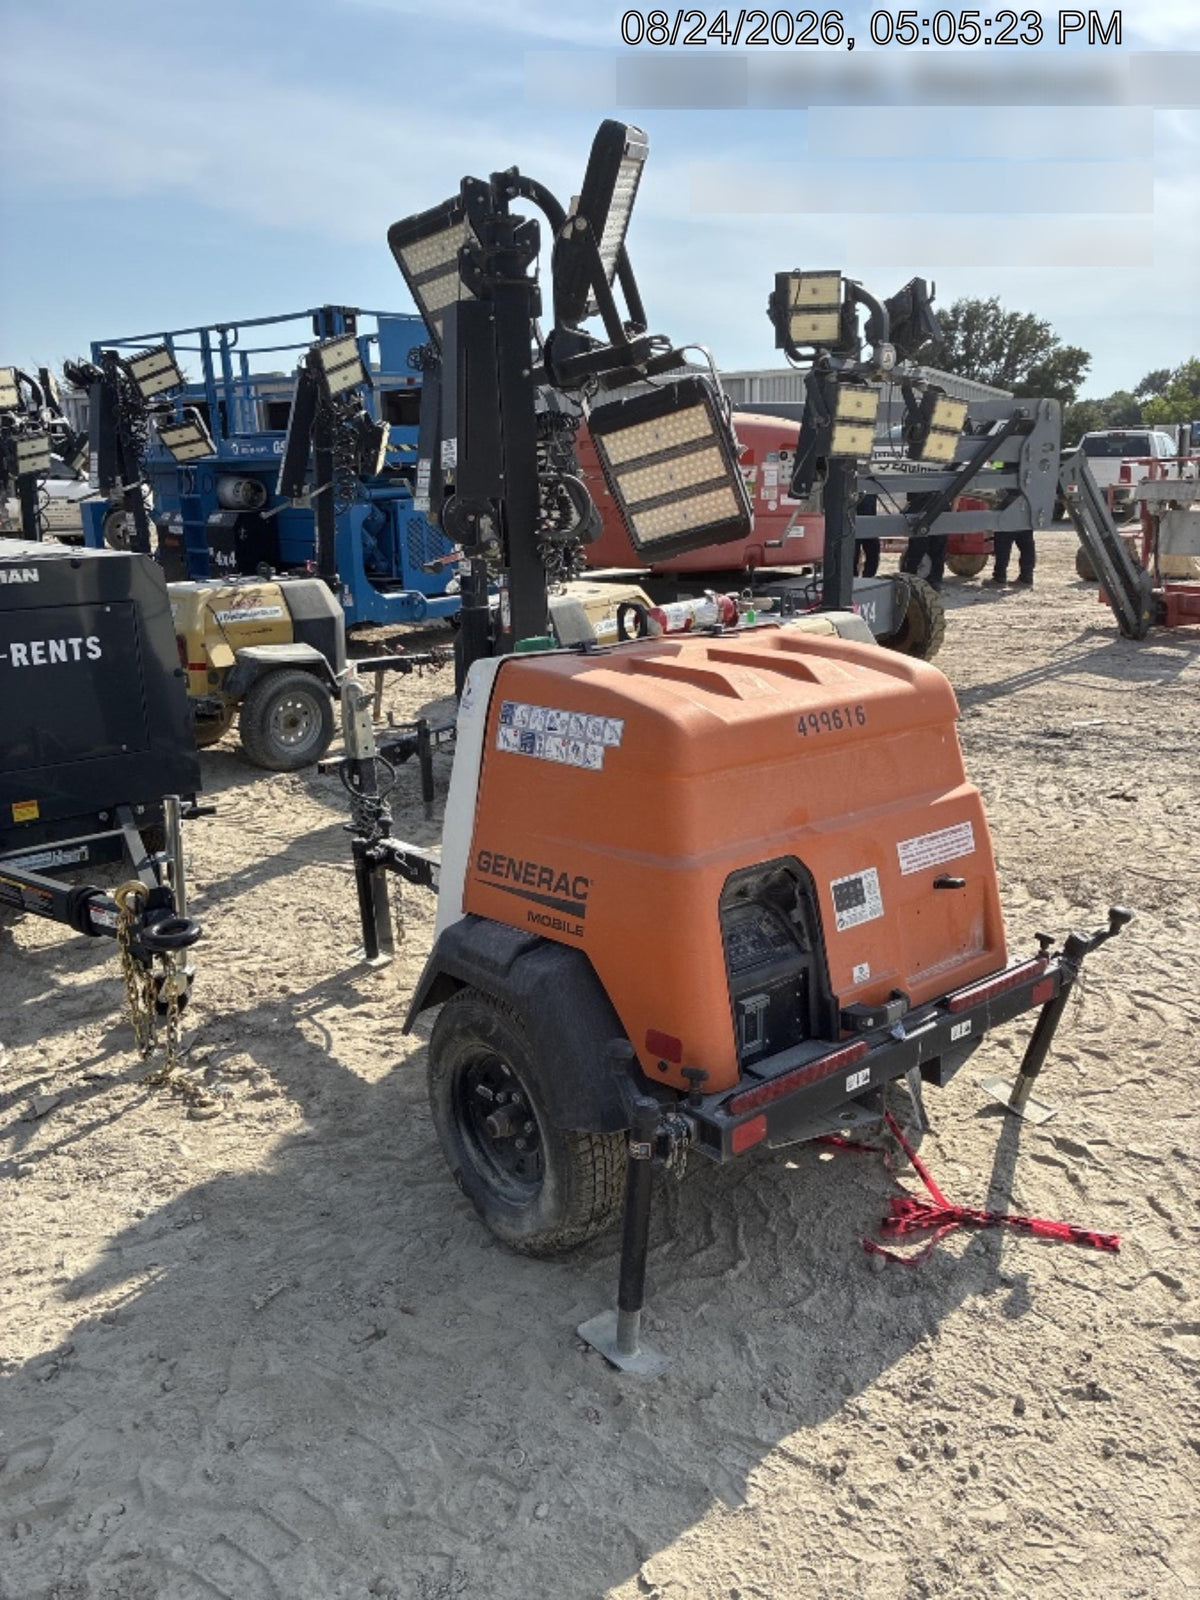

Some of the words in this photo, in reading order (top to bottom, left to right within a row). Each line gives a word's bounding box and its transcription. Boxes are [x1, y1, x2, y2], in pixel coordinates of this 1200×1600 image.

[215, 550, 237, 567] 4x4
[797, 705, 866, 736] 499616
[476, 850, 589, 900] GENERAC
[527, 910, 585, 937] MOBILE
